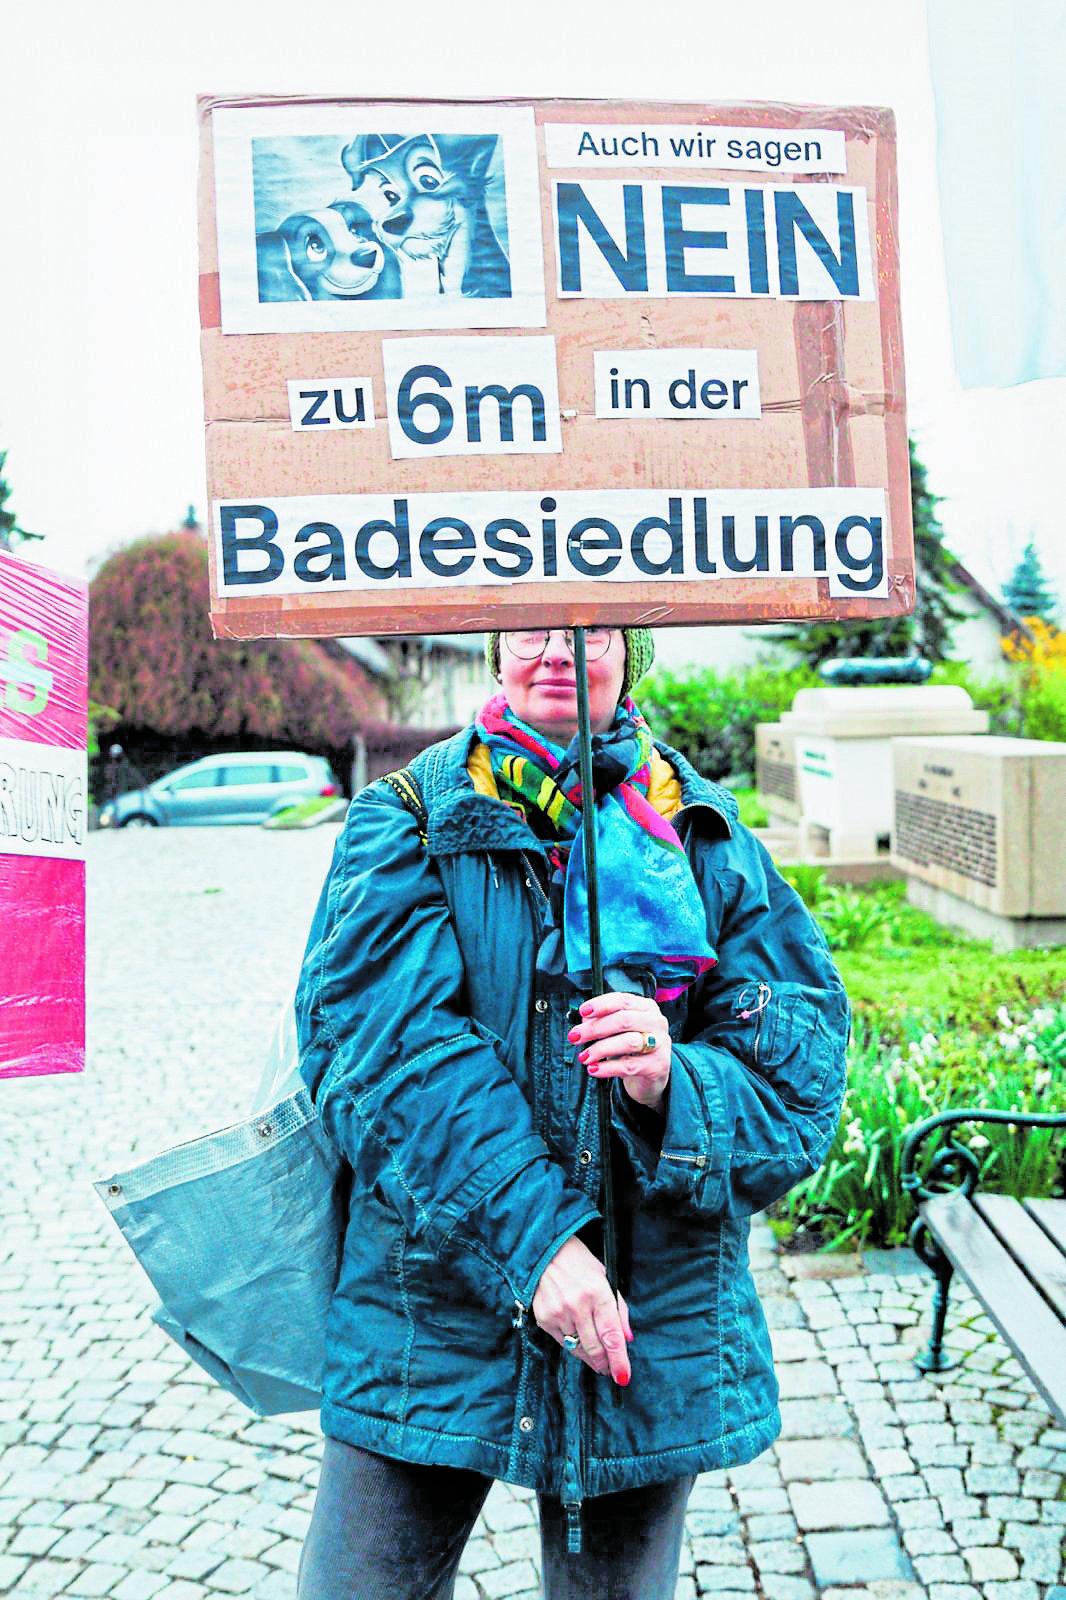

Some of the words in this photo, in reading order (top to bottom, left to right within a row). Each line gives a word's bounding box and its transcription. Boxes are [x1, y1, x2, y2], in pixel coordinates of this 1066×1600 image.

[577, 131, 660, 157] Auch
[670, 132, 717, 158] wir
[727, 138, 823, 166] sagen
[556, 182, 861, 297] NEIN
[299, 386, 367, 424] zu
[396, 364, 547, 446] 6m
[609, 367, 651, 410] in
[668, 369, 749, 411] der
[219, 496, 884, 592] Badesiedlung
